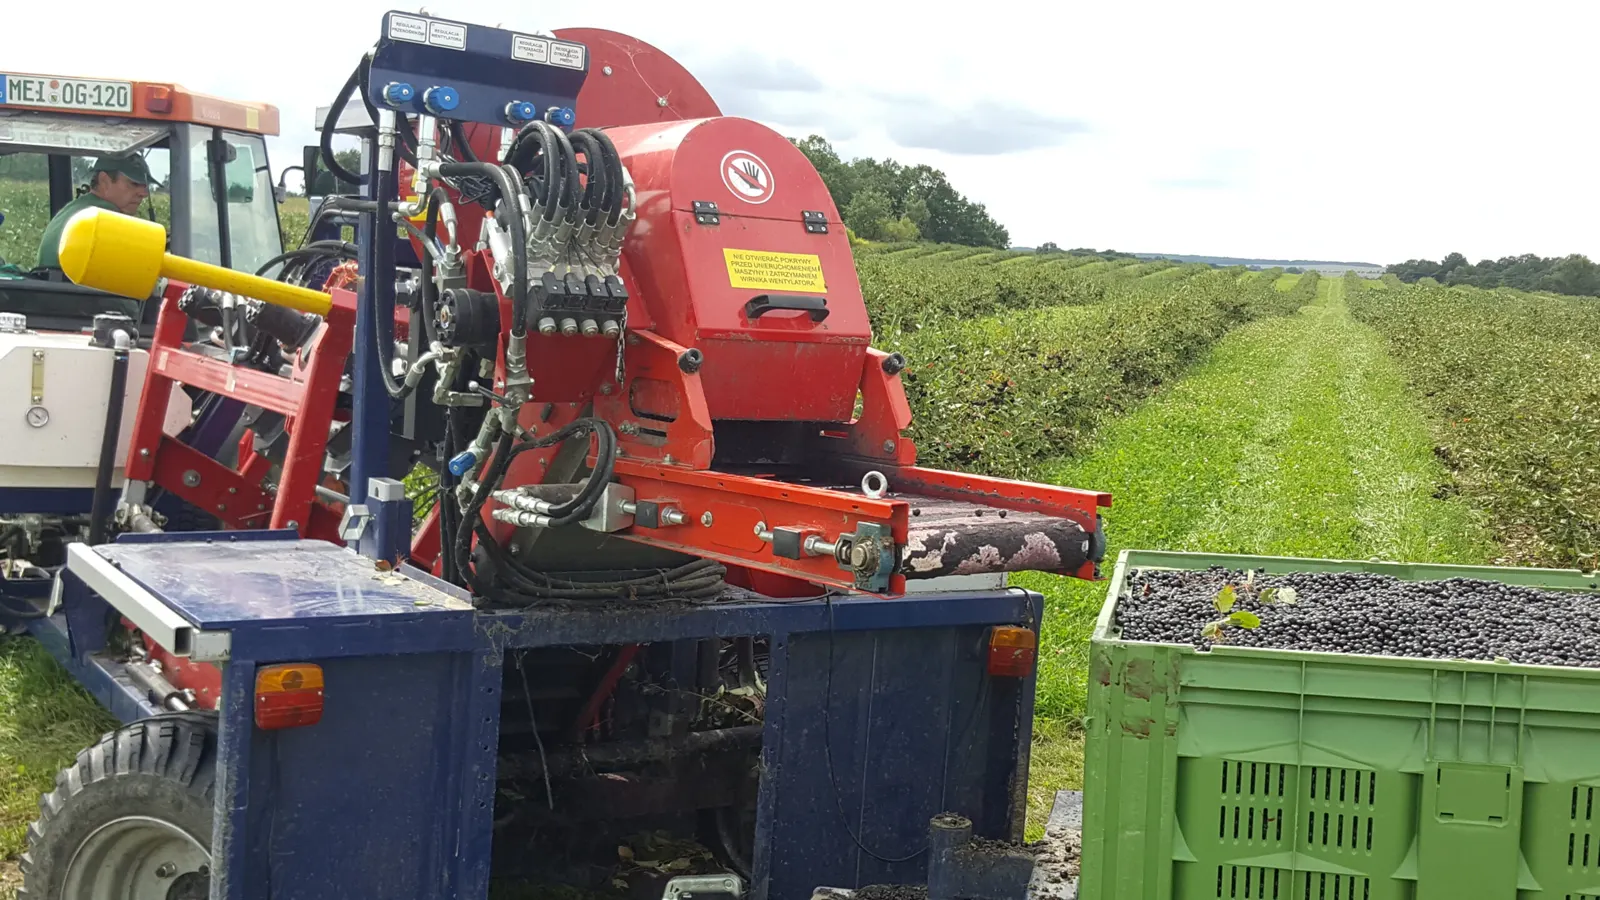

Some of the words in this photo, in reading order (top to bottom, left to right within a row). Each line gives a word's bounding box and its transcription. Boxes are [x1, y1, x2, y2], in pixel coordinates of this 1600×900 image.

[8, 79, 46, 102] MEI
[731, 260, 753, 268] PRZED
[780, 257, 812, 265] POKRYWY
[734, 268, 765, 276] MASZYNY
[770, 270, 818, 280] ZATRZYMANIEM
[740, 276, 768, 284] WIRNIKA
[769, 277, 816, 286] WENTYLATORA
